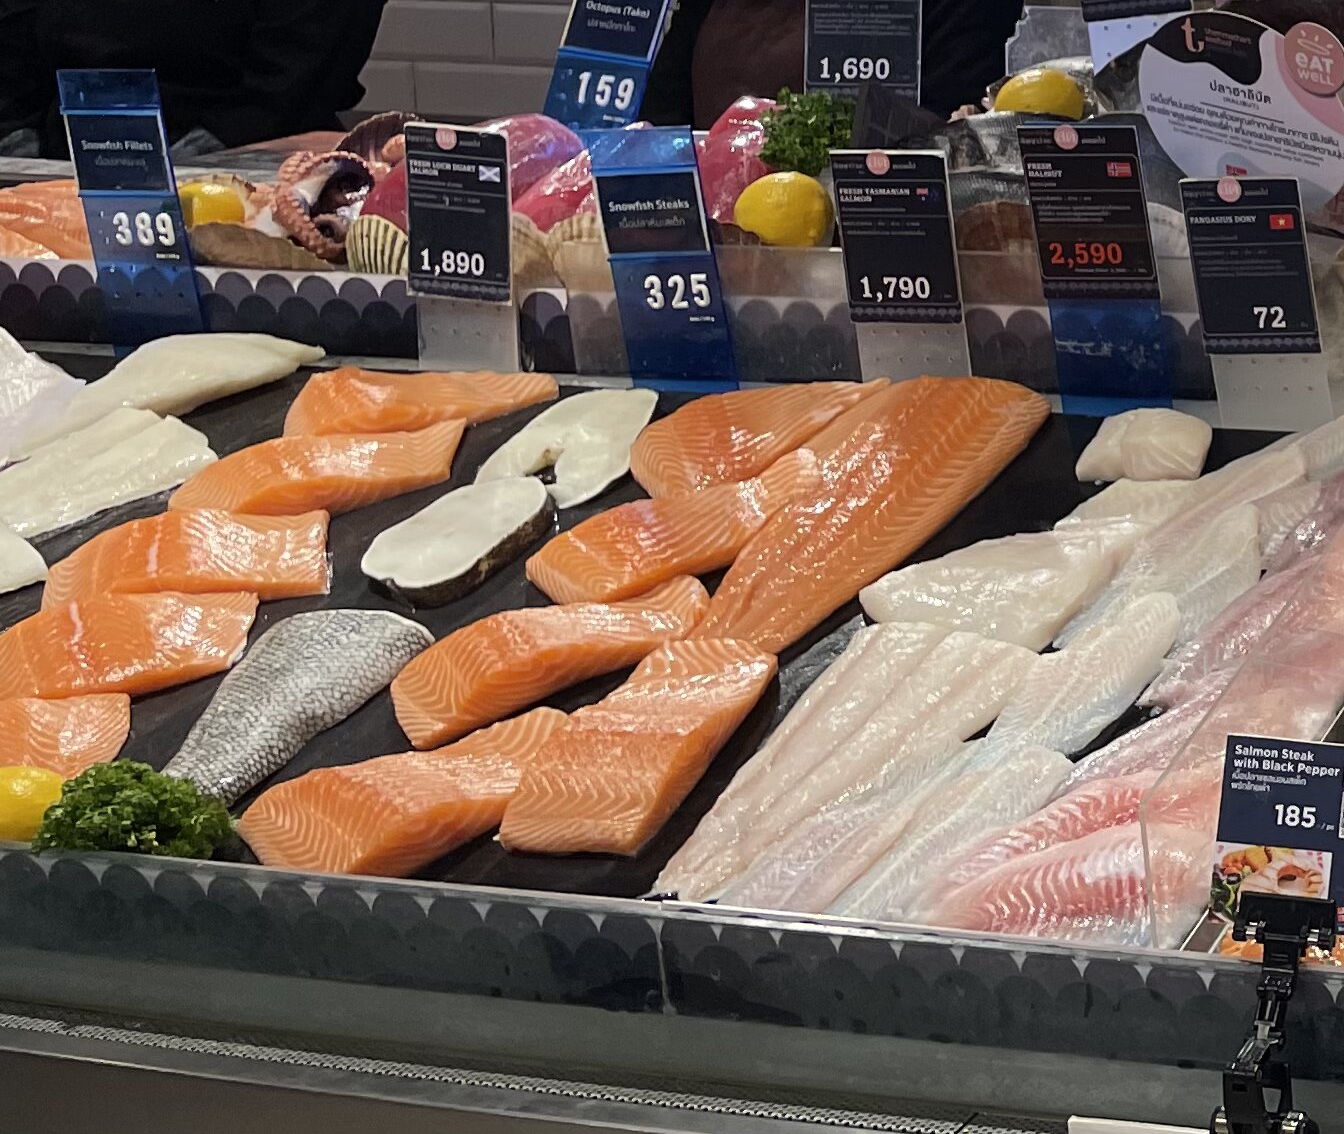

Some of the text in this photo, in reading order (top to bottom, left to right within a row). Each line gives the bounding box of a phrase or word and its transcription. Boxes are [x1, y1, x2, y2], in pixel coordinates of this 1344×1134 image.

[585, 0, 651, 19] Octopus (Tako)
[819, 57, 890, 83] 1,690
[577, 71, 635, 111] 159
[81, 139, 154, 151] Snowfish Fillets
[608, 198, 690, 212] Snowfish Steaks
[113, 212, 176, 246] 389
[420, 247, 485, 277] 1,890
[1049, 242, 1123, 268] 2,590
[643, 273, 711, 310] 325
[859, 276, 930, 303] 1,790
[1253, 305, 1287, 329] 72
[1234, 744, 1315, 762] Salmon Steak
[1233, 757, 1341, 777] with Black Pepper
[1275, 803, 1317, 829] 185
